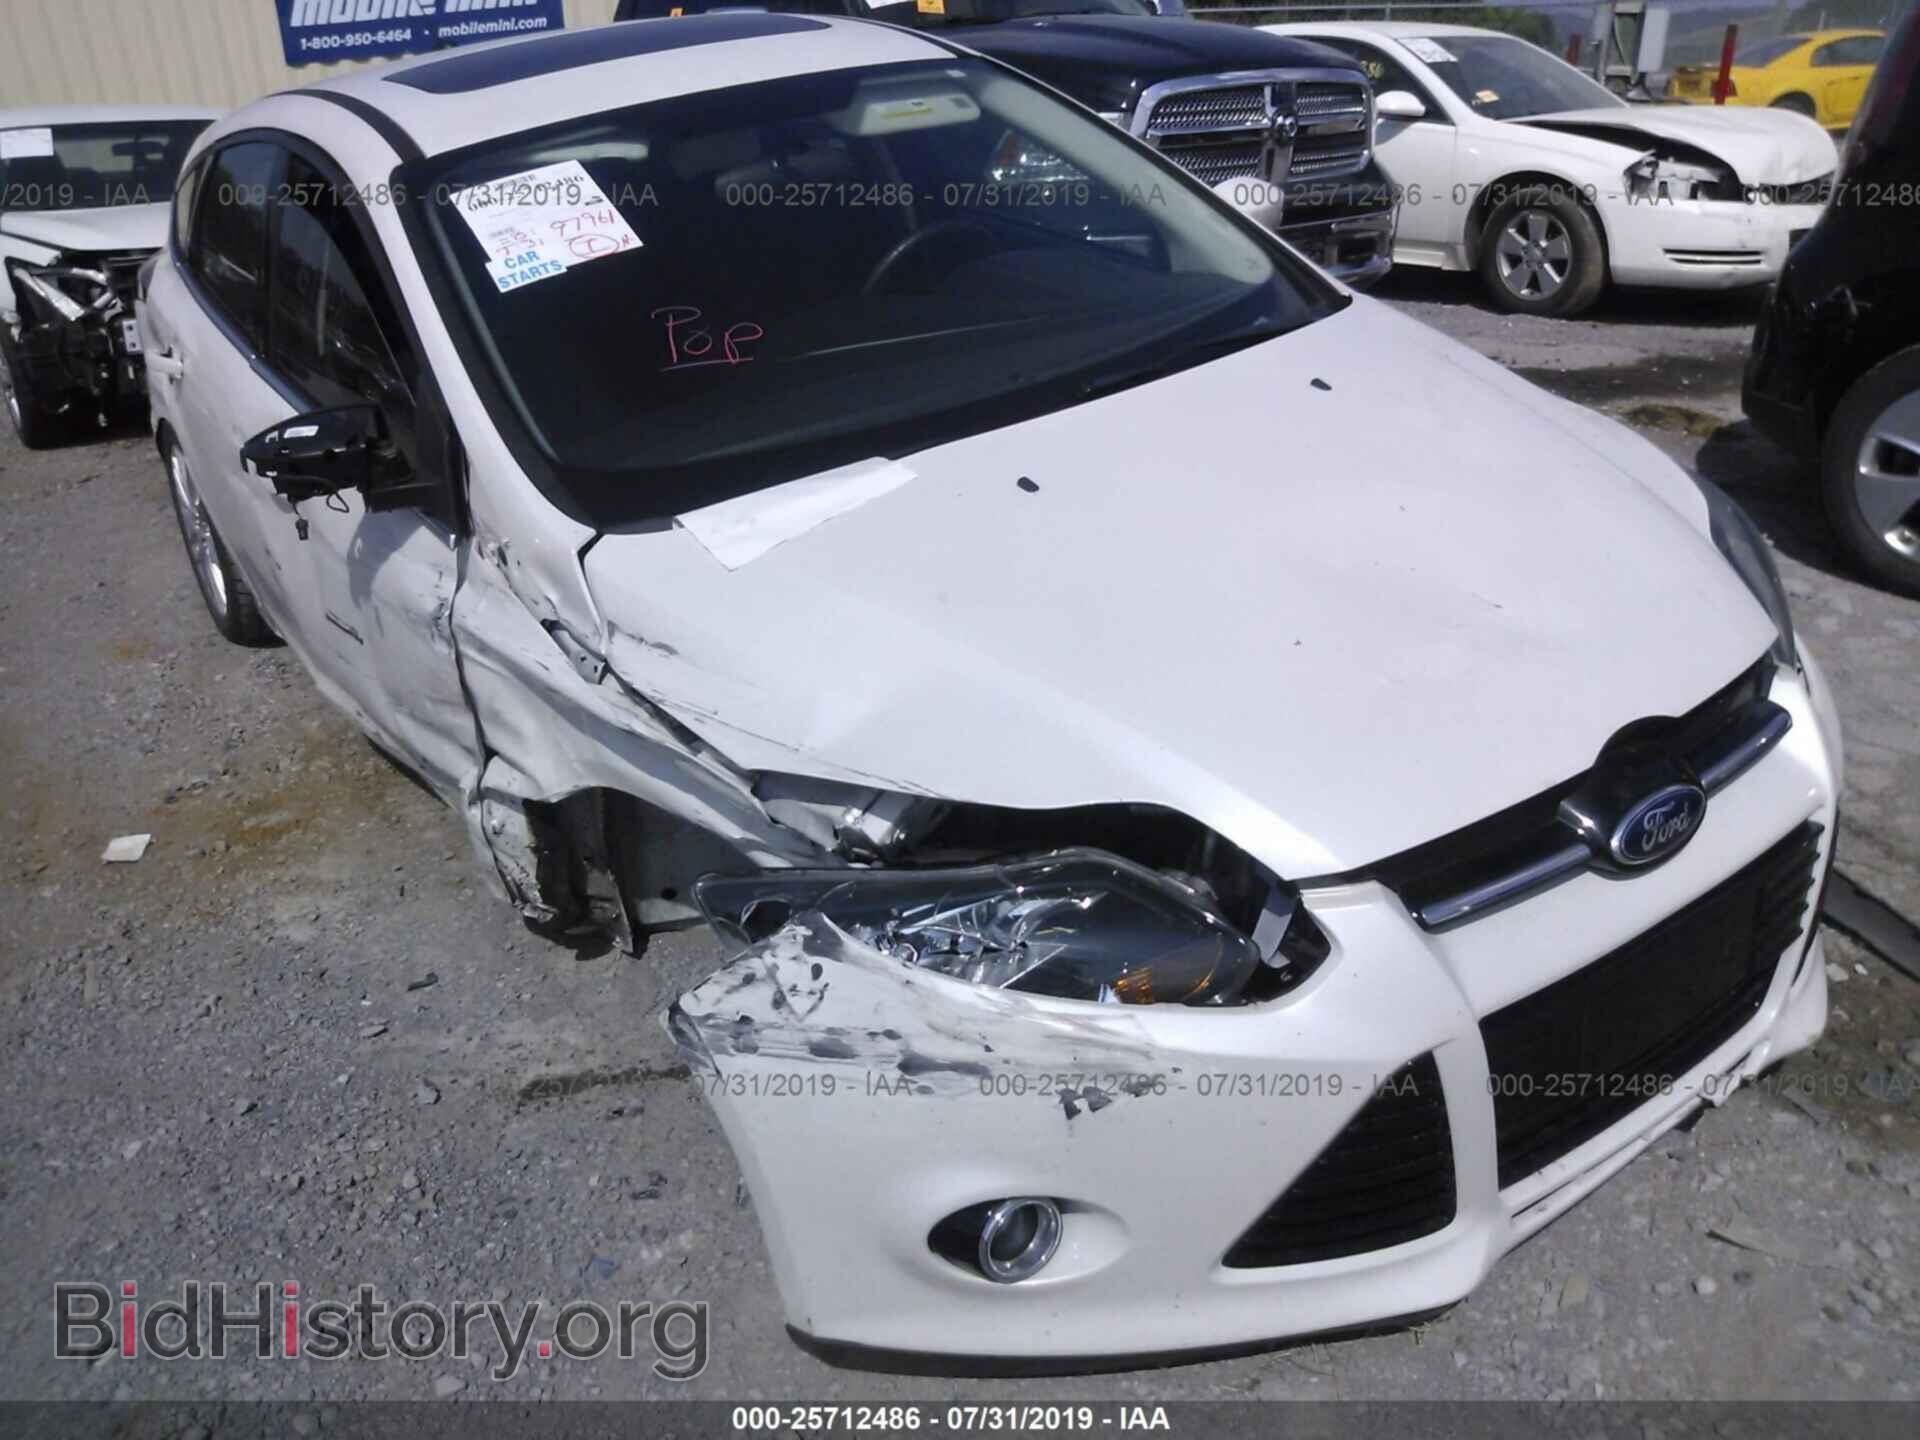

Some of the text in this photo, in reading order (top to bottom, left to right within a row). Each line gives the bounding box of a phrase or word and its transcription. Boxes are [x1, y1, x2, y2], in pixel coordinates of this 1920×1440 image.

[301, 17, 547, 50] 1-800-950-6464 mobilemini.com
[498, 260, 563, 289] STARTS
[504, 250, 541, 270] CAR
[1642, 800, 1691, 852] Ford
